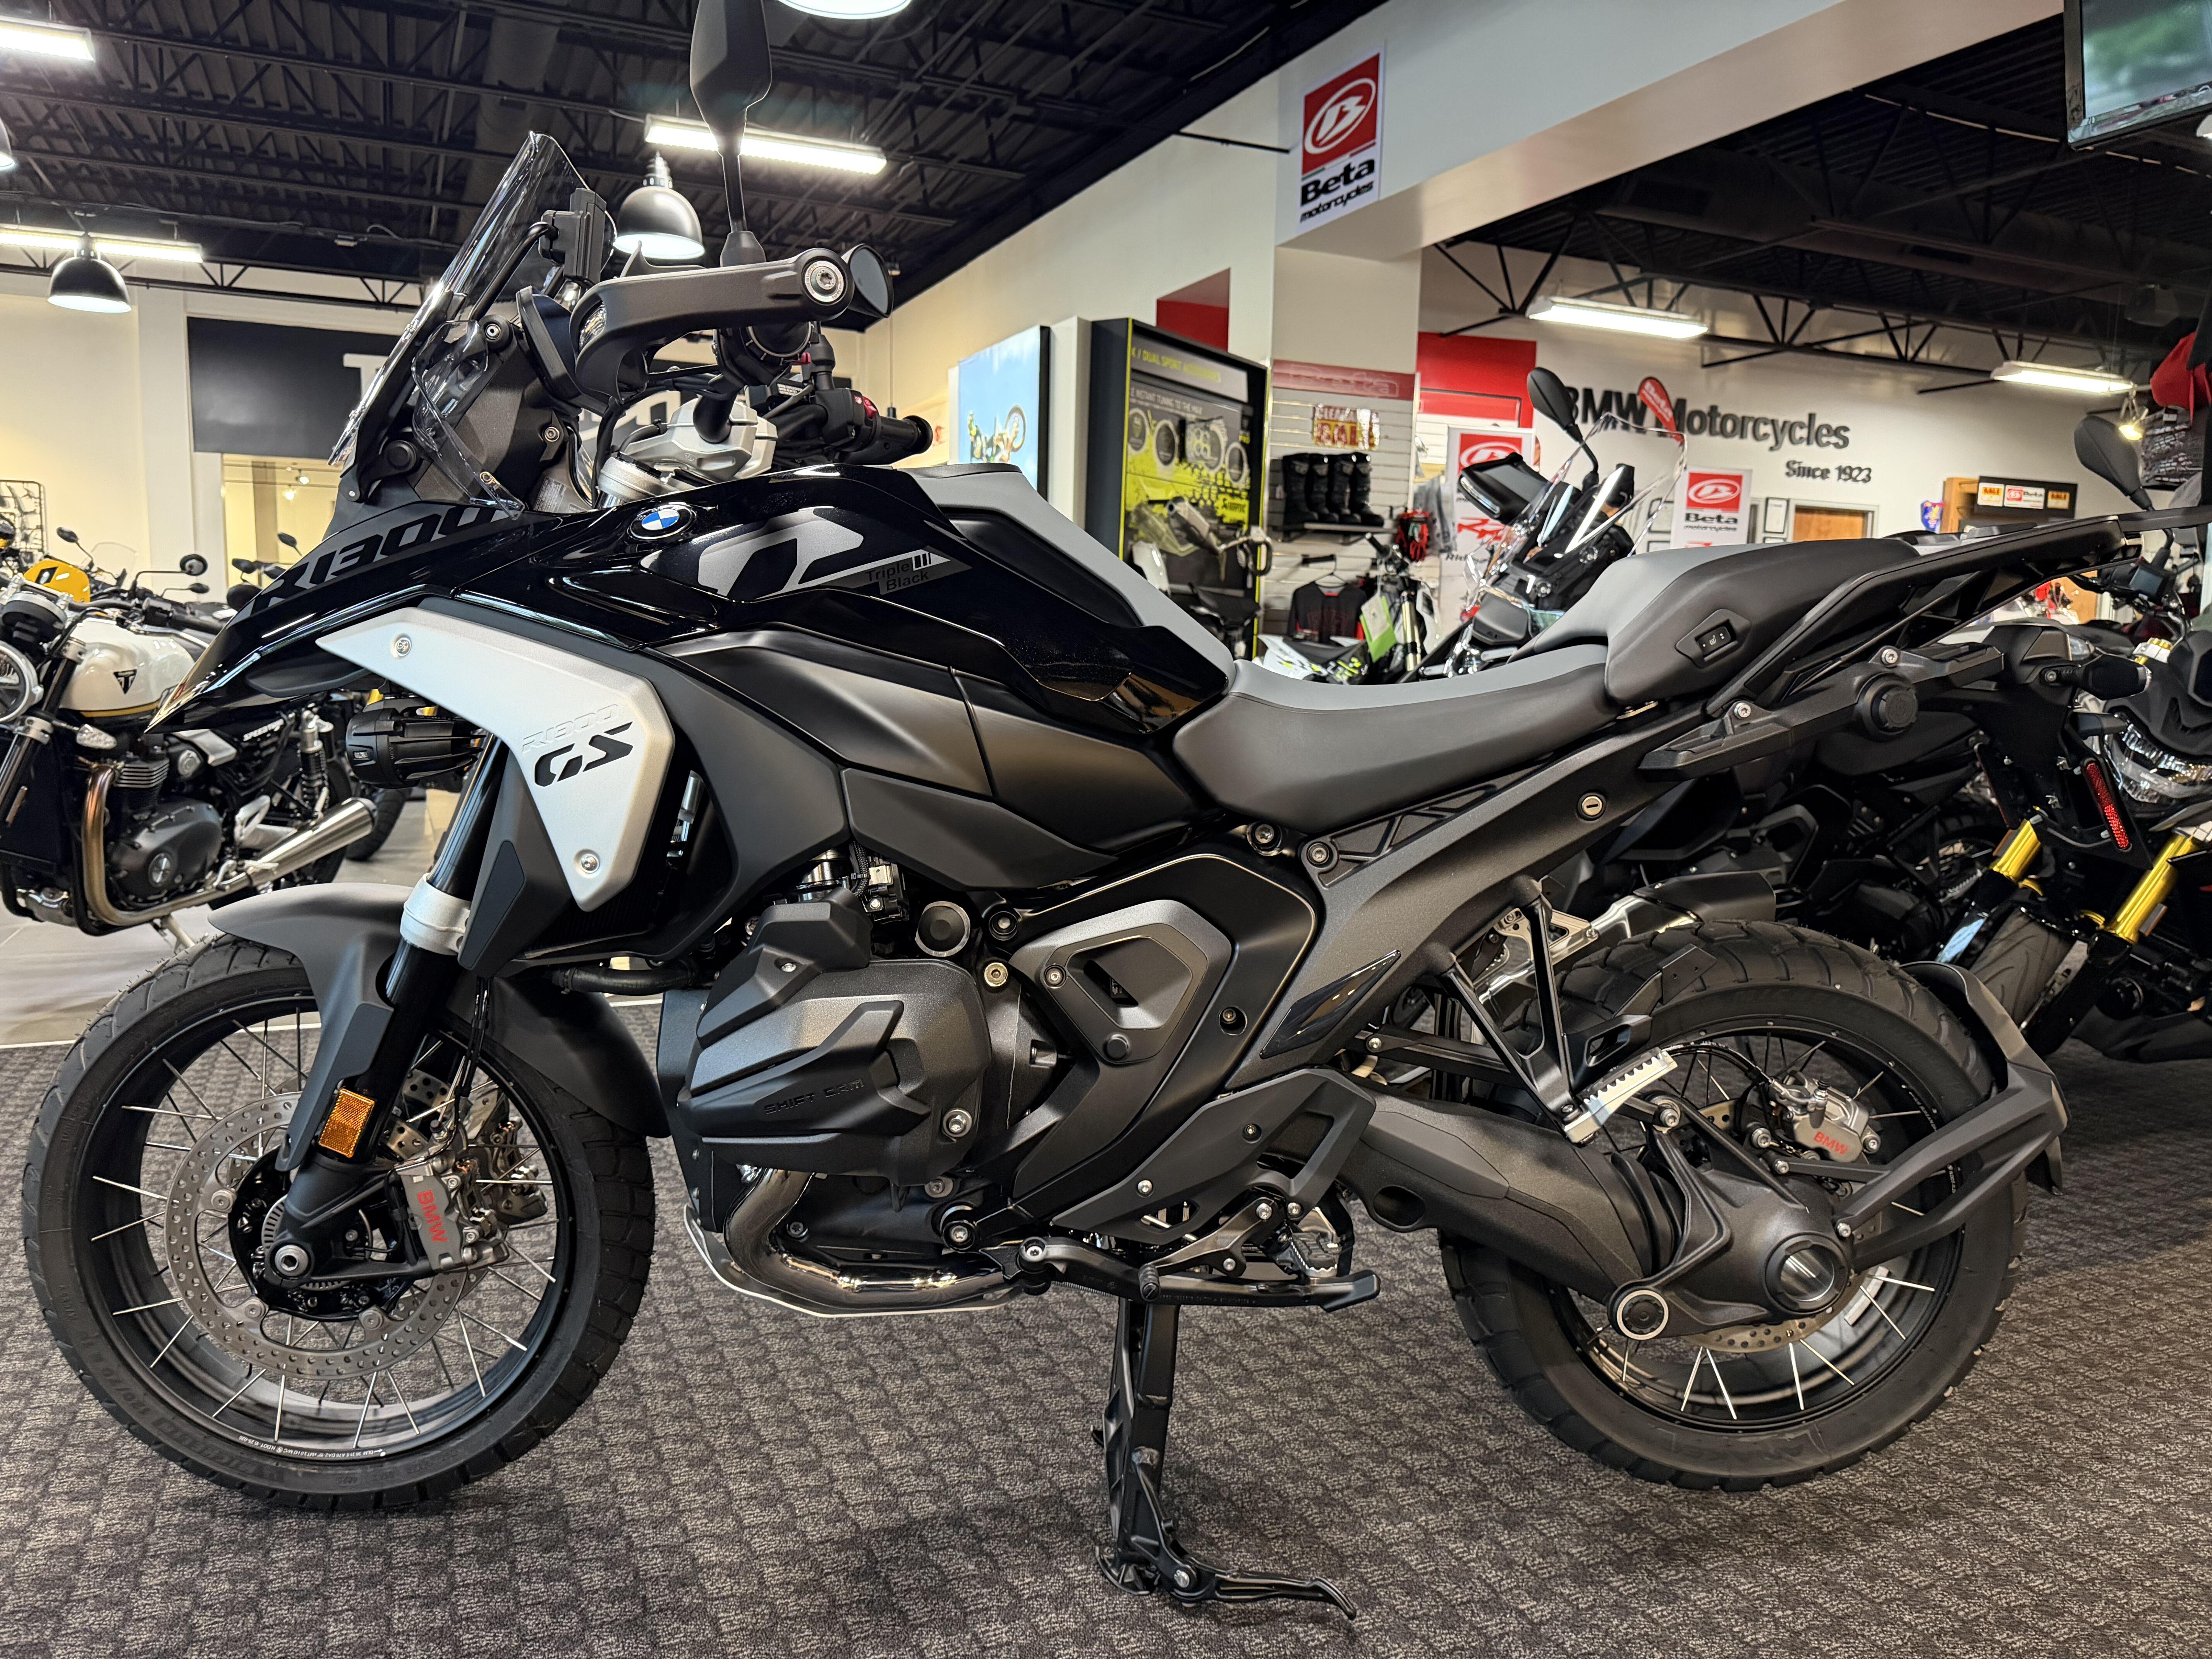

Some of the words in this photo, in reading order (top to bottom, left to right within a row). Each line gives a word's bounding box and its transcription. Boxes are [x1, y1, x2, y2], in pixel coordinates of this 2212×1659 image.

[1300, 180, 1374, 223] motorcycles
[1301, 159, 1375, 207] Beta
[1785, 459, 1831, 480] Since
[1835, 465, 1872, 484] 1923
[1685, 513, 1738, 524] Beta
[251, 505, 498, 617] R1300
[865, 563, 910, 582] Triple
[886, 570, 929, 591] Black
[522, 704, 618, 754] R1300
[534, 721, 634, 787] GS
[764, 1092, 815, 1115] SHIFT
[823, 1079, 865, 1098] CAM
[1814, 1132, 1850, 1155] BMW
[417, 1190, 448, 1242] BMW
